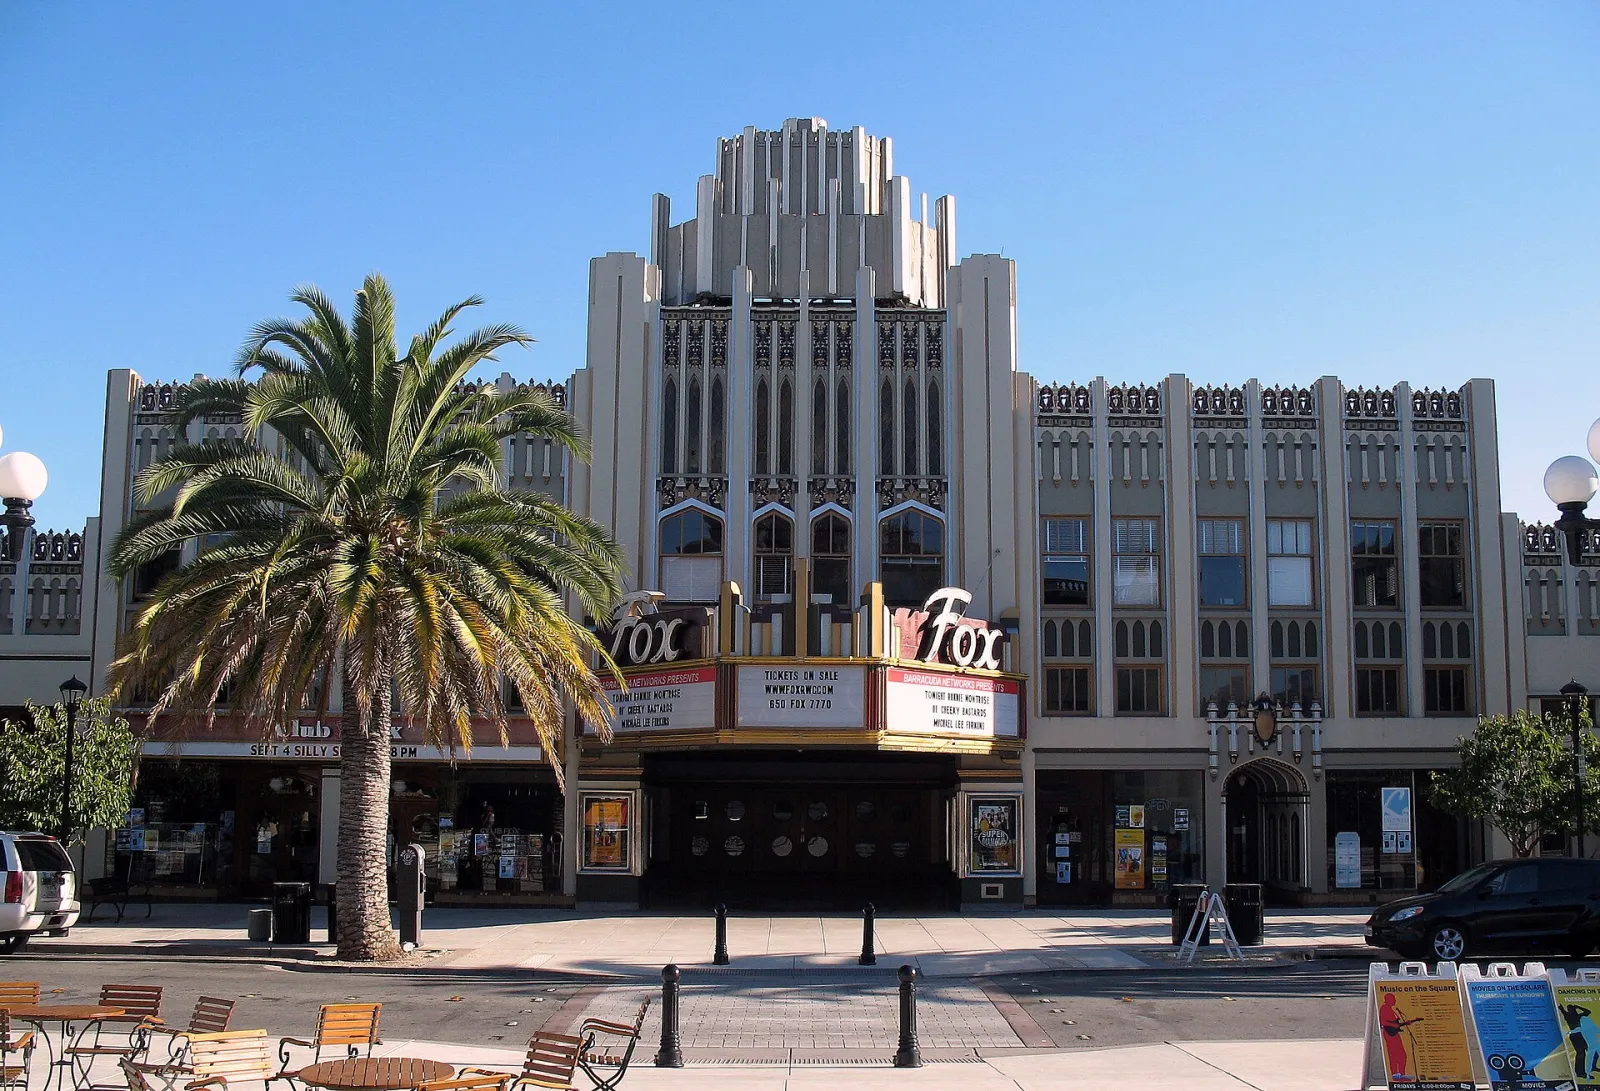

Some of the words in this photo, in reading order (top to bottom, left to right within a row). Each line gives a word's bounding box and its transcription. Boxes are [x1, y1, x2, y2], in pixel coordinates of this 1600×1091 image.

[634, 676, 667, 687] NETWORKS
[667, 673, 699, 684] PRESENTS
[764, 671, 799, 680] TICKETS
[804, 671, 814, 680] ON
[819, 671, 839, 680] SALE
[903, 673, 941, 685] BARRACUDA
[942, 677, 975, 689] NETWORKS
[975, 680, 1004, 692] PRESENTS
[925, 690, 945, 701] TONIGHT
[965, 694, 990, 704] MONTROSE
[769, 700, 786, 709] 650
[790, 700, 805, 709] FOX
[810, 700, 832, 709] 7770
[941, 706, 960, 715] CHEEKY
[962, 707, 987, 717] BASTARDS
[642, 718, 651, 727] LEE
[933, 719, 953, 728] MICHAEL
[955, 720, 964, 729] LEE
[283, 745, 290, 756] 4
[294, 745, 327, 756] SILLY
[1144, 800, 1171, 811] OPEN
[982, 830, 1005, 838] SUPER
[1415, 984, 1427, 992] the
[1428, 984, 1456, 993] Square
